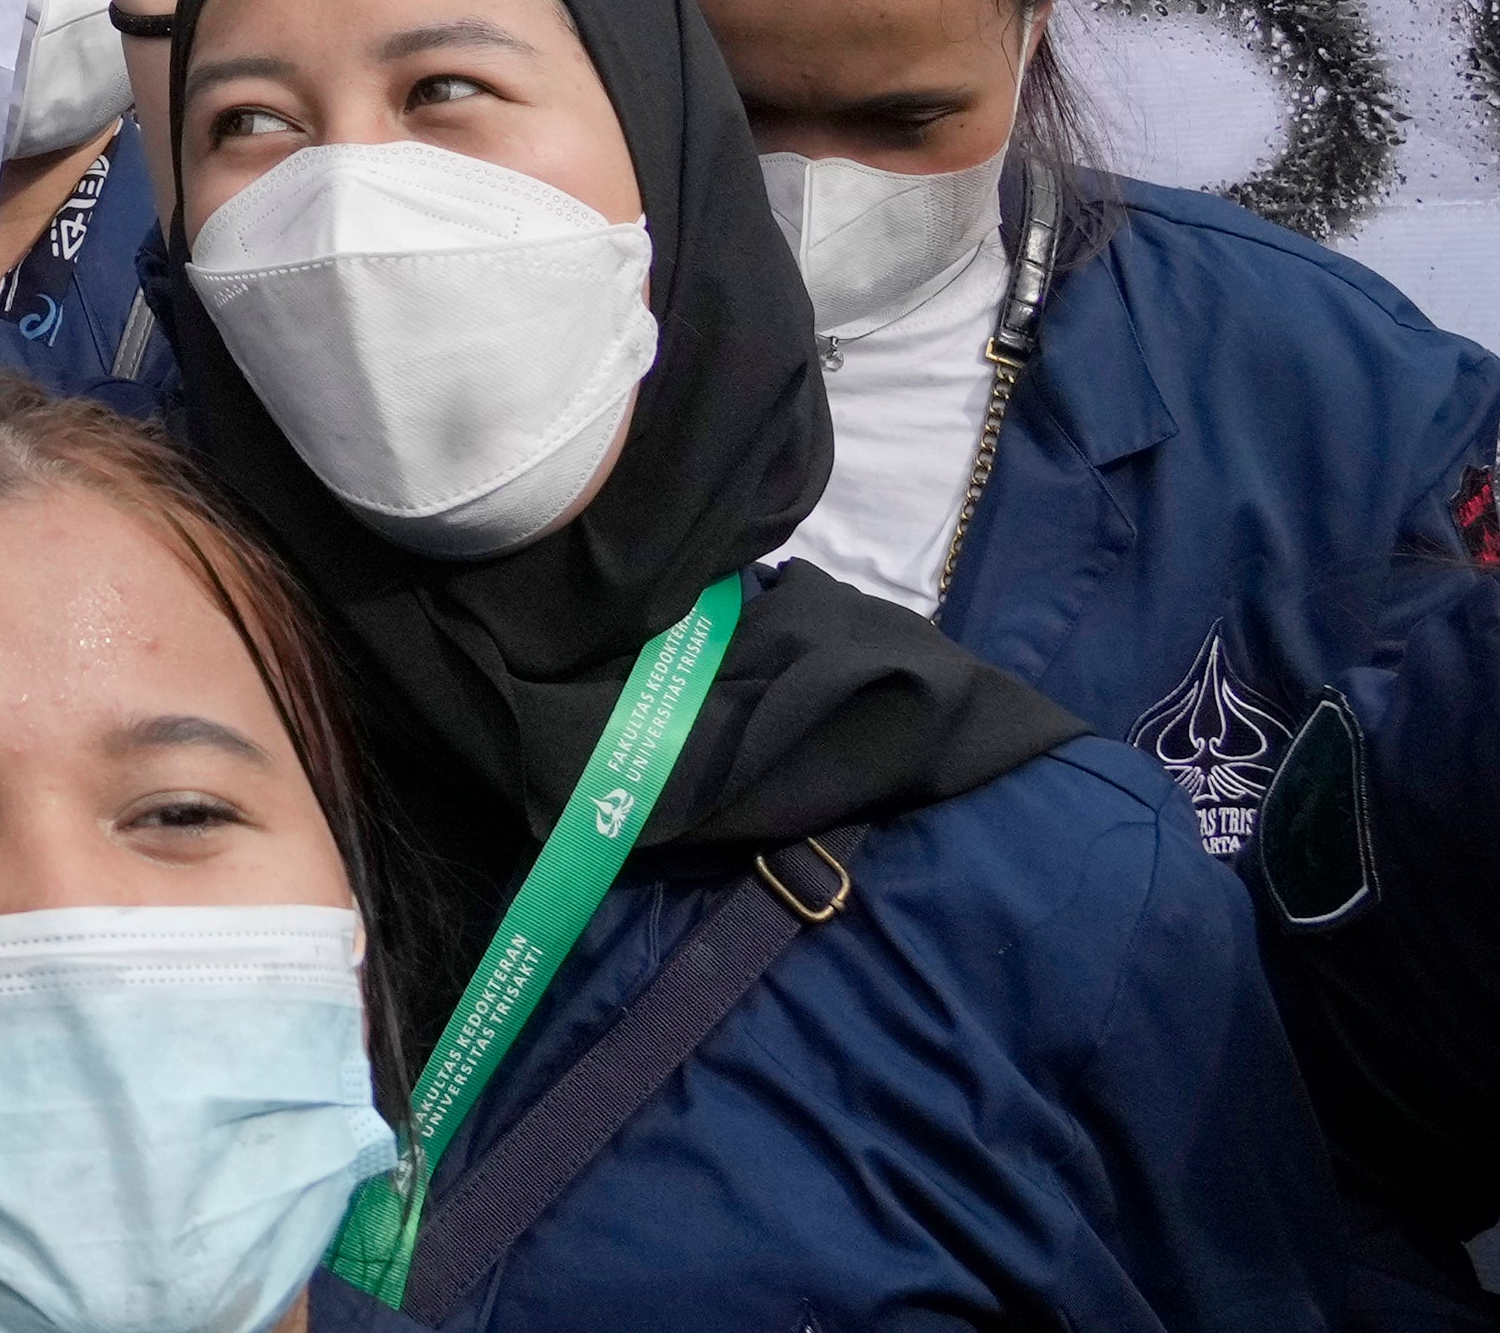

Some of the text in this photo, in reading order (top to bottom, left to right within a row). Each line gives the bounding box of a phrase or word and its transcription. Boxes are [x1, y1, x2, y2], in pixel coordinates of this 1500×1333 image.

[608, 691, 655, 773] FAKULTAS
[626, 616, 712, 782] UNIVERSITAS TRISAKTI
[1218, 807, 1258, 835] TRIS
[415, 933, 527, 1123] AKULTAS KEDOKTERAN
[421, 945, 544, 1138] UNIVERSITAS TRISAKTI
